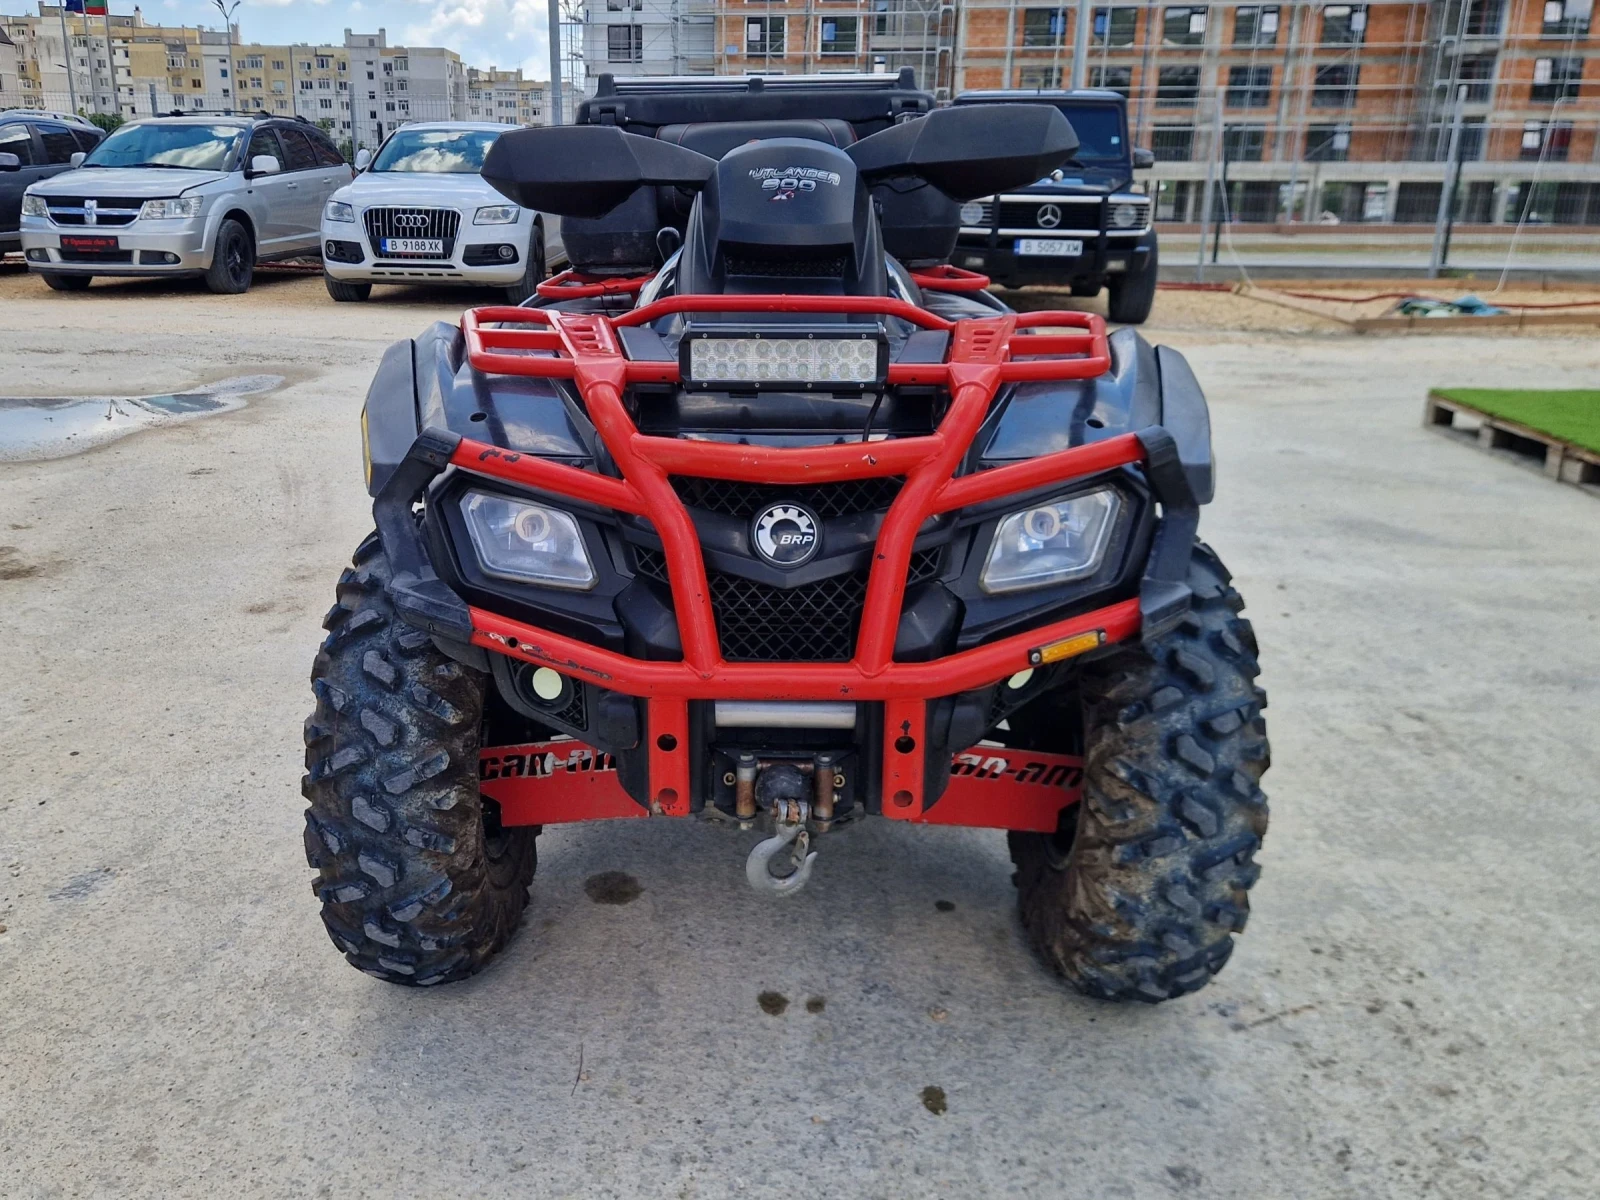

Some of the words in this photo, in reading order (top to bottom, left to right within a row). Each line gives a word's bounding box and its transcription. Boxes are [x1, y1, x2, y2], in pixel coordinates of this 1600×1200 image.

[391, 240, 398, 251] B
[402, 240, 426, 251] 9188
[428, 241, 441, 251] XK
[779, 534, 814, 545] BRP
[949, 752, 1084, 787] an-am
